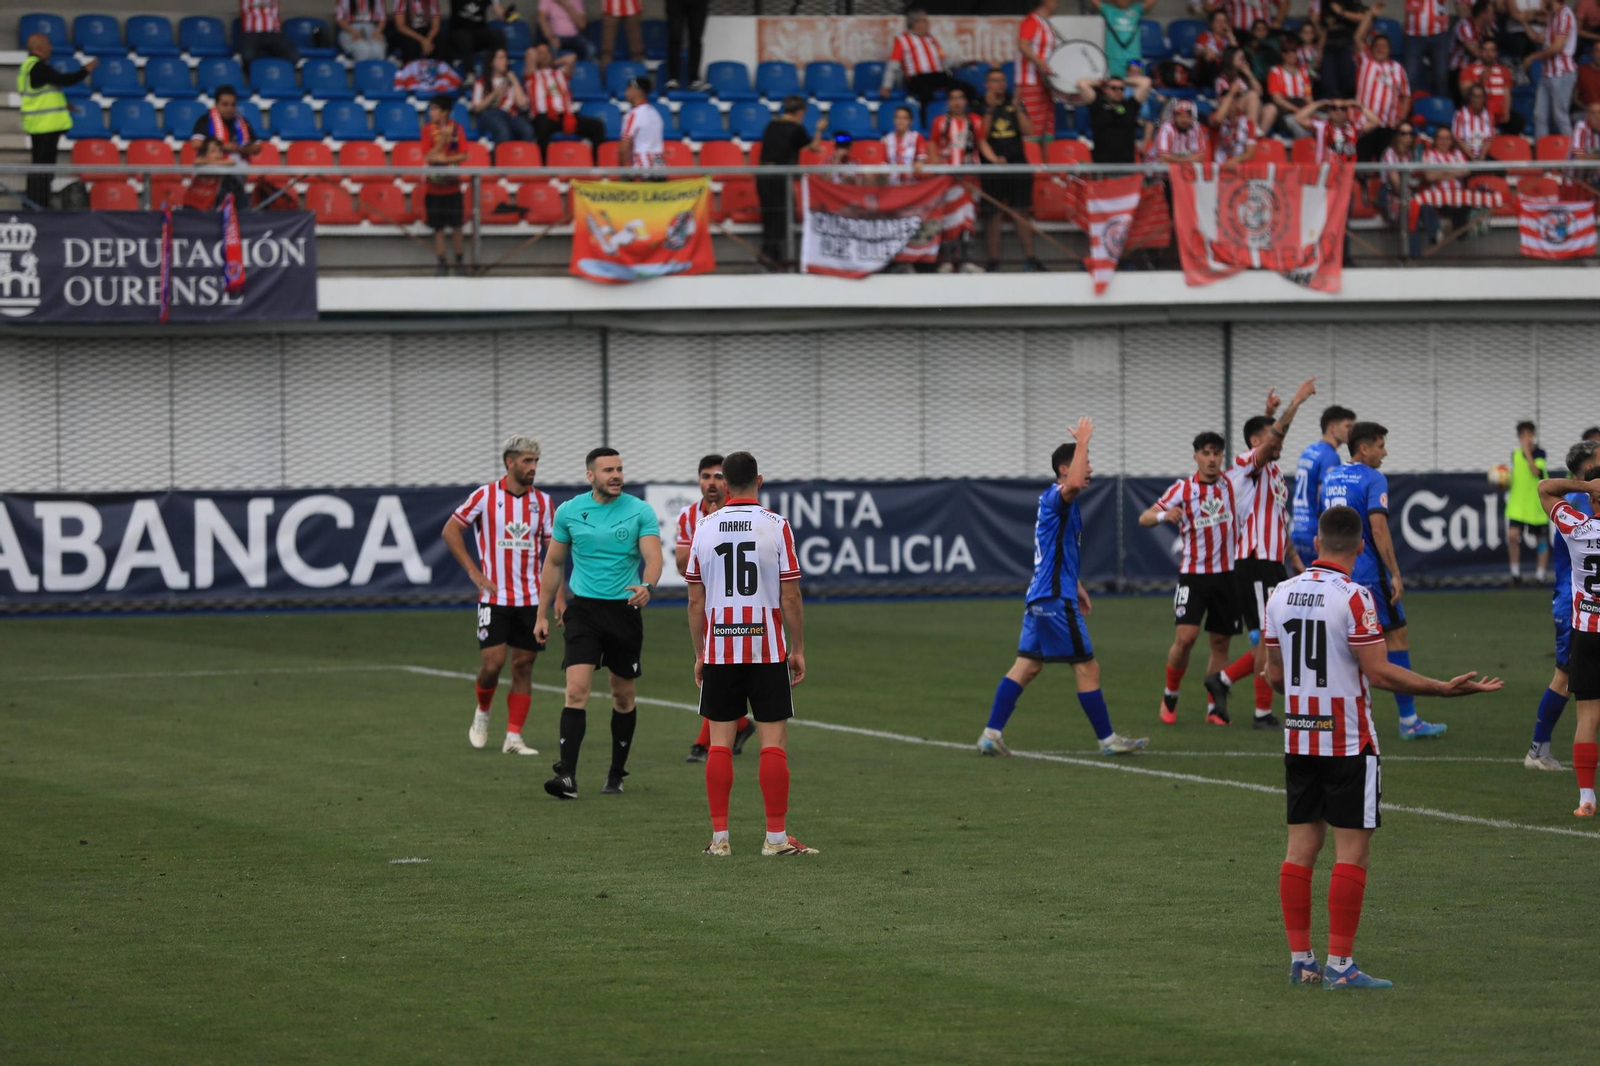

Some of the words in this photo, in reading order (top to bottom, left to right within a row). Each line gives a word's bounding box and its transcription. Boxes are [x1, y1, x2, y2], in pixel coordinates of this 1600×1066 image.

[63, 229, 307, 268] DEPUTACIÓN
[1326, 485, 1347, 497] LUCAS
[762, 491, 883, 529] UNTA
[719, 520, 753, 532] MARKEL
[800, 534, 977, 576] GALICIA
[713, 541, 758, 597] 16
[1177, 586, 1190, 605] 19
[1287, 592, 1315, 607] DIEGO
[478, 606, 491, 626] 20
[713, 625, 764, 636] leomotor.net
[1282, 618, 1328, 688] 14
[1286, 718, 1334, 729] omotor.net
